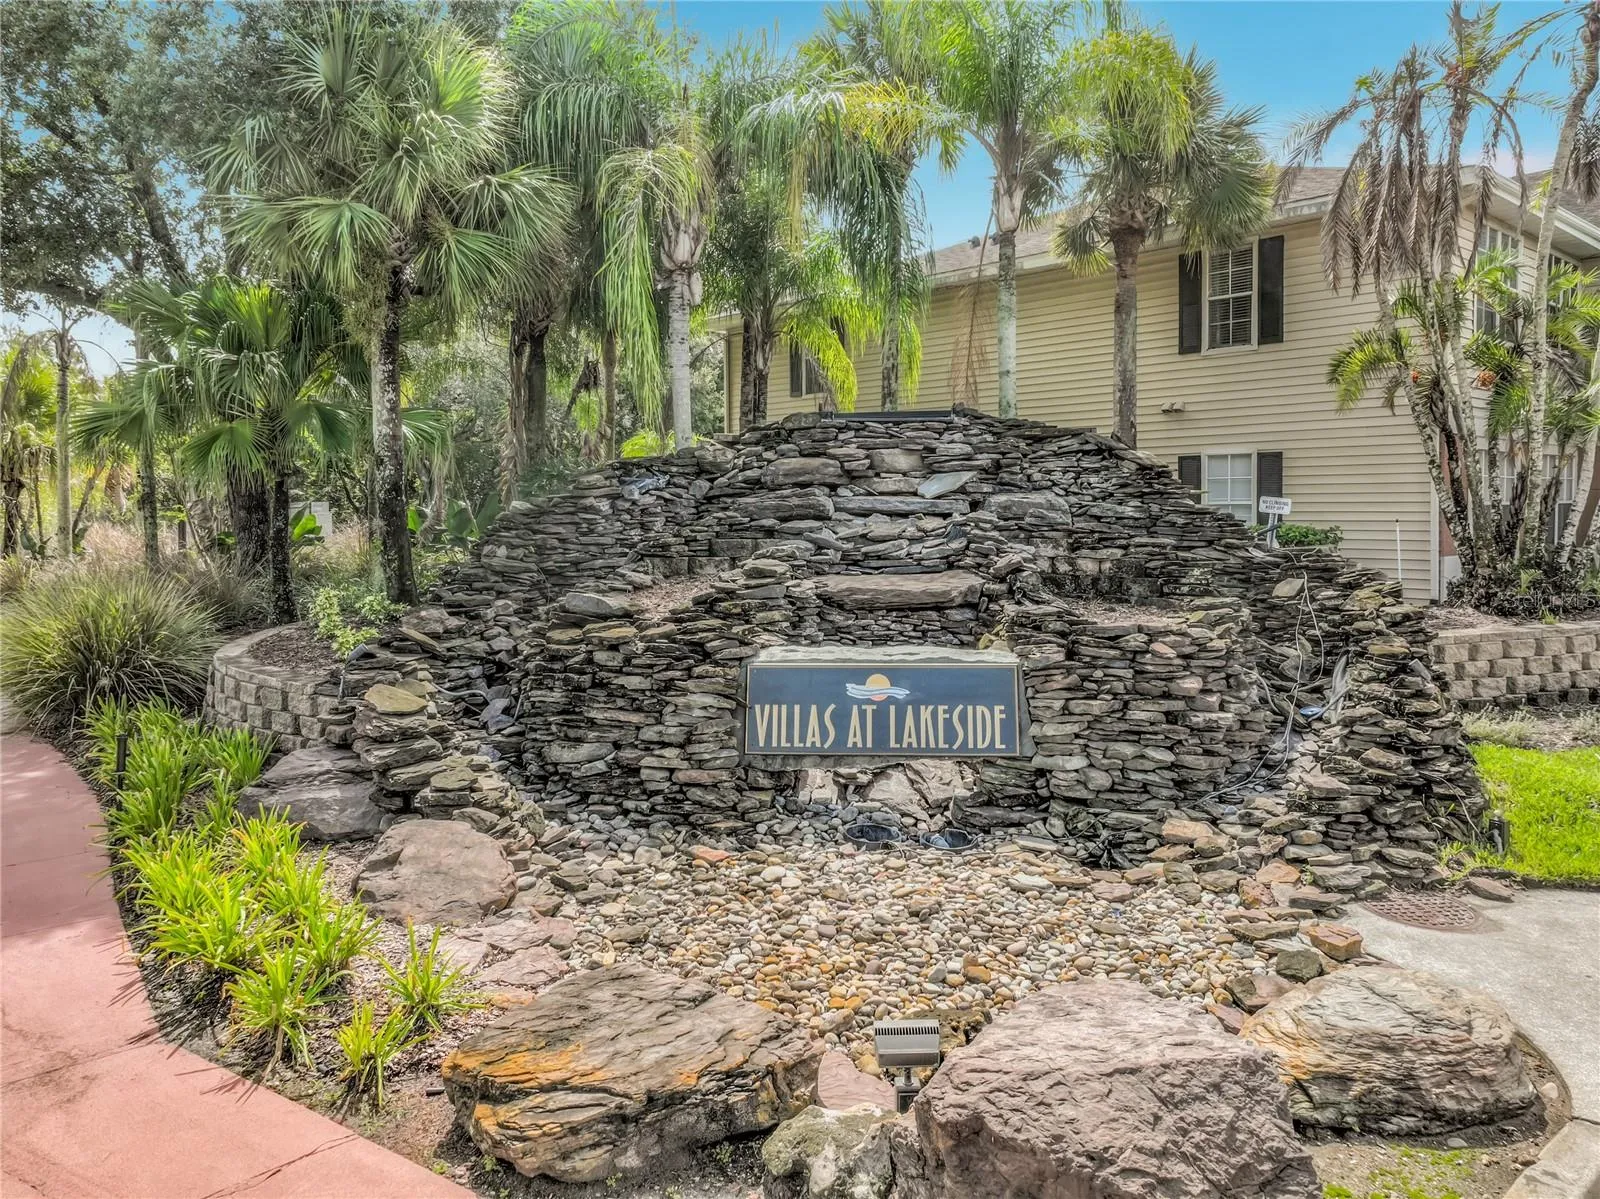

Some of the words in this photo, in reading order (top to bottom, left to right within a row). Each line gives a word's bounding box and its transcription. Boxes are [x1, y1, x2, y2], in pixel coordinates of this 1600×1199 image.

[754, 703, 837, 749] VILLAS
[846, 704, 877, 749] AT
[889, 704, 1006, 750] LAKESIDE
